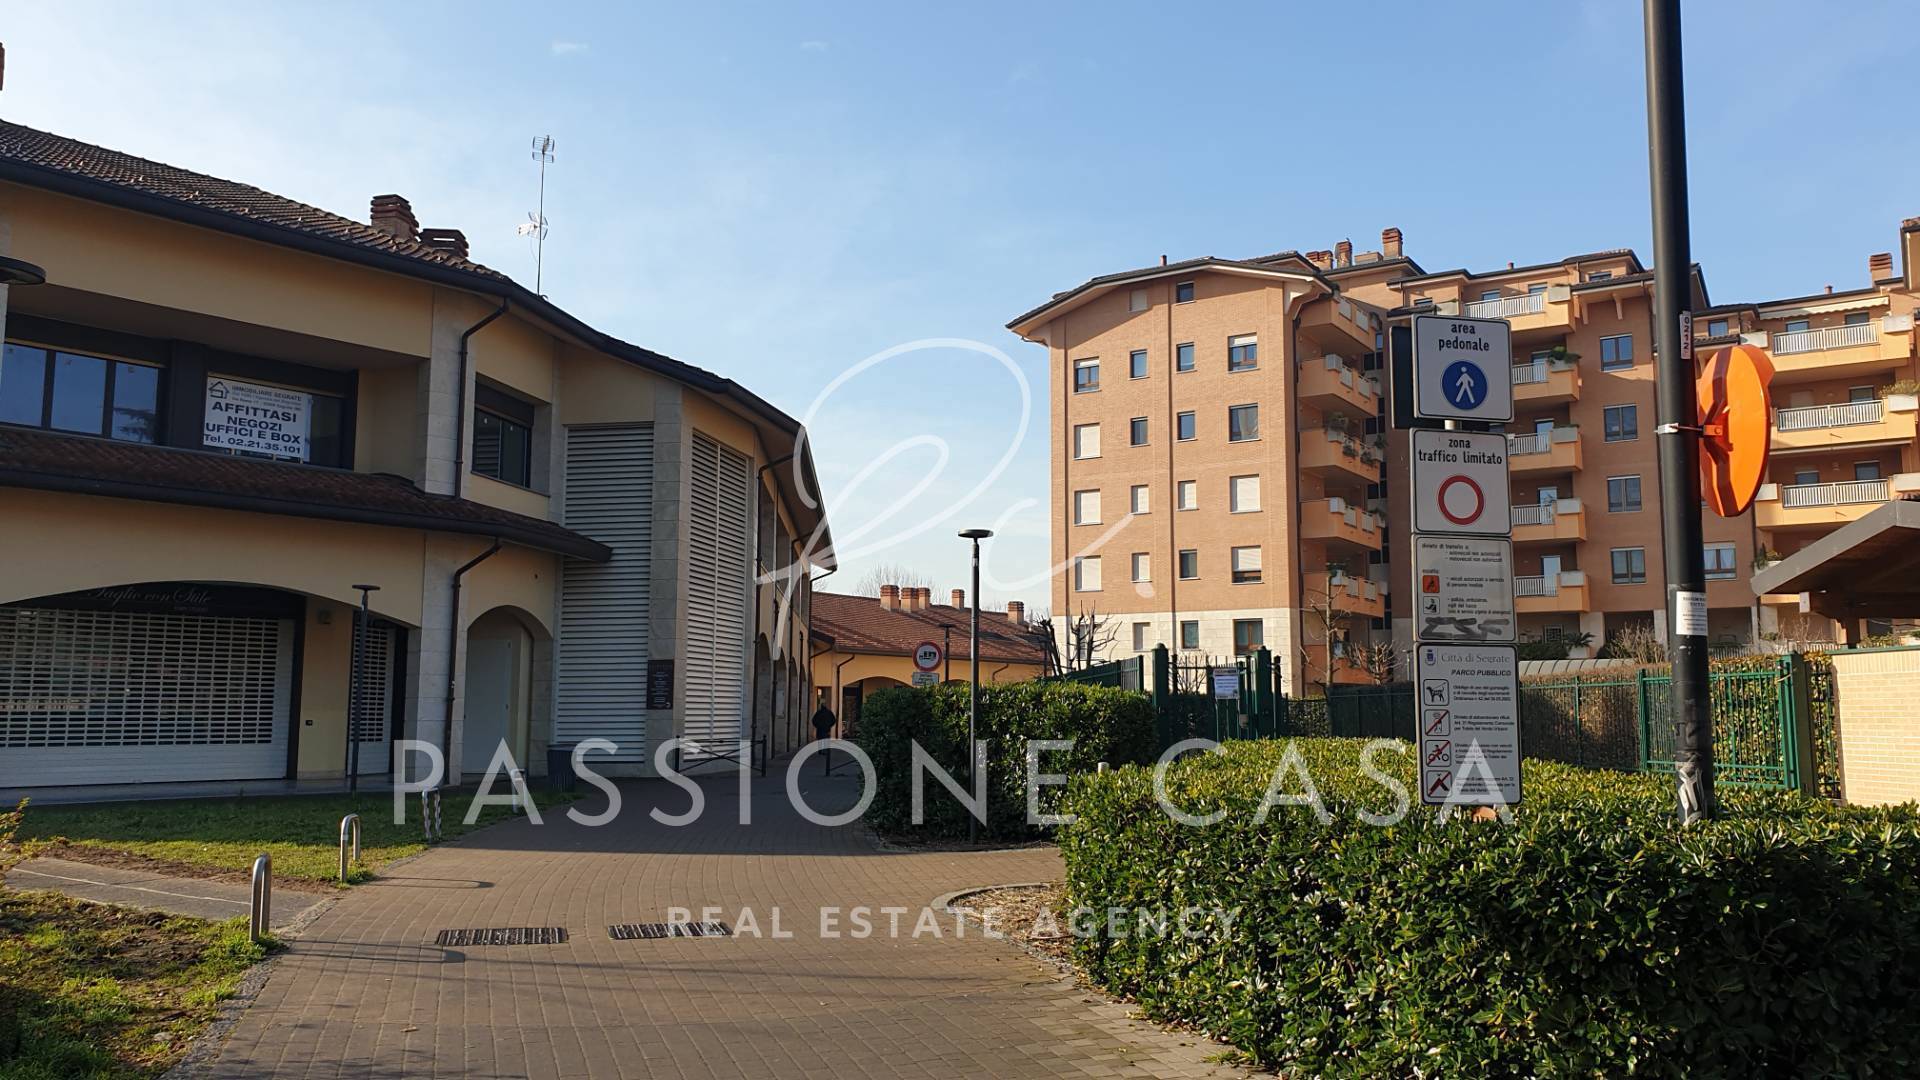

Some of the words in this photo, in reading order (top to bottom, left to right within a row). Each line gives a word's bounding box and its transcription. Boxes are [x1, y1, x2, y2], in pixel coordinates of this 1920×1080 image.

[1451, 323, 1476, 334] area
[1438, 336, 1490, 351] pedonale
[211, 401, 297, 423] AFFITTASI
[226, 415, 282, 432] NEGOZI
[205, 422, 253, 438] UFFICI
[257, 430, 266, 440] E
[270, 431, 301, 445] BOX
[203, 434, 224, 444] Tel.
[227, 437, 301, 454] 02.21.35.101
[1448, 438, 1471, 448] zona
[1418, 449, 1457, 463] traffico
[1463, 451, 1503, 465] limitato
[1465, 652, 1474, 663] di
[1476, 653, 1511, 664] Segrate
[1476, 669, 1512, 677] PUBBLICO
